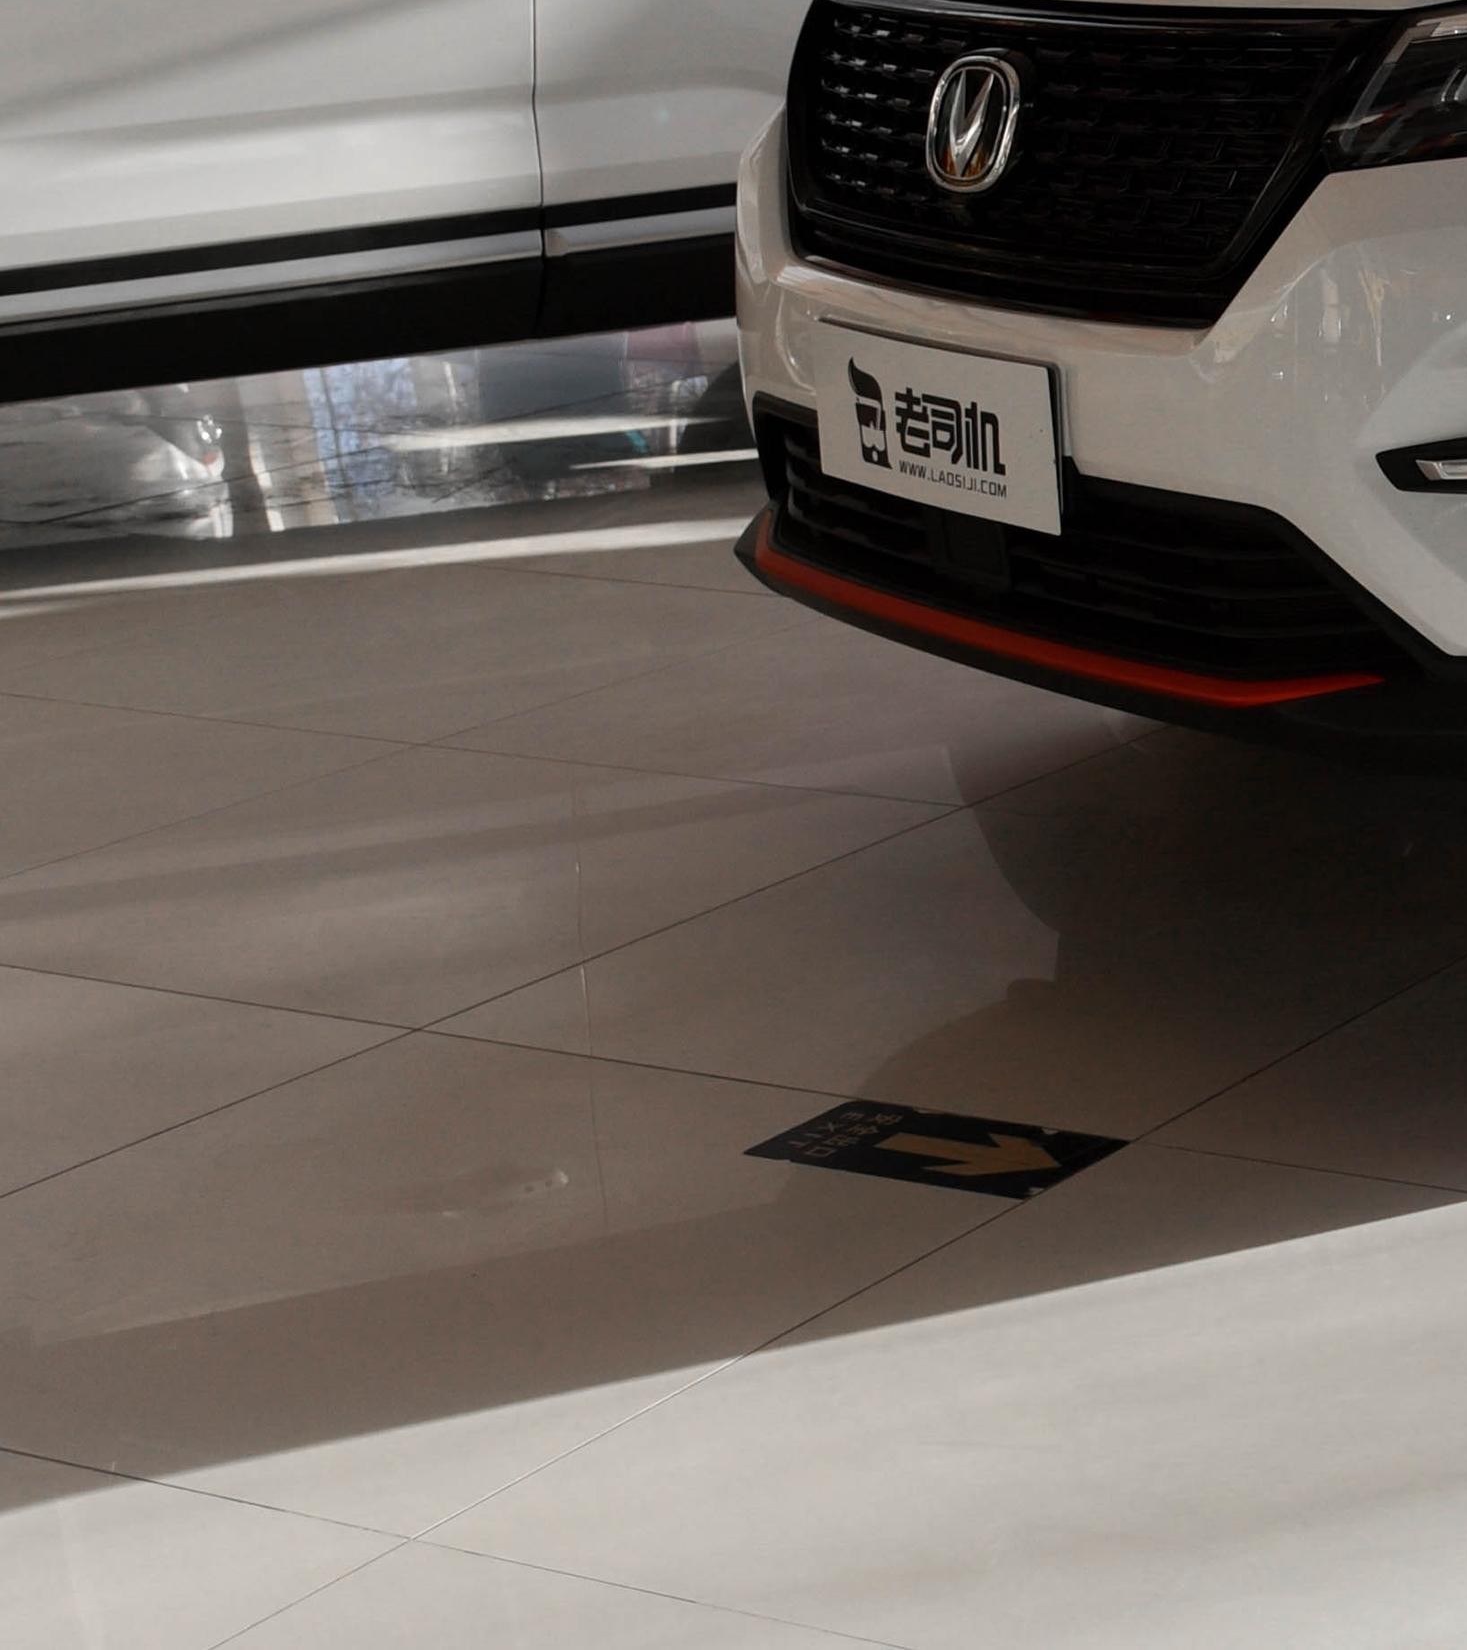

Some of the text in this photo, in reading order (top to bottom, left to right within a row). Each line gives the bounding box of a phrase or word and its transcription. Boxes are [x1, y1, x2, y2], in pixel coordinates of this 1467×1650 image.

[895, 386, 1006, 477] 老司机
[899, 459, 1008, 499] WWW.LAOSIJI.COM
